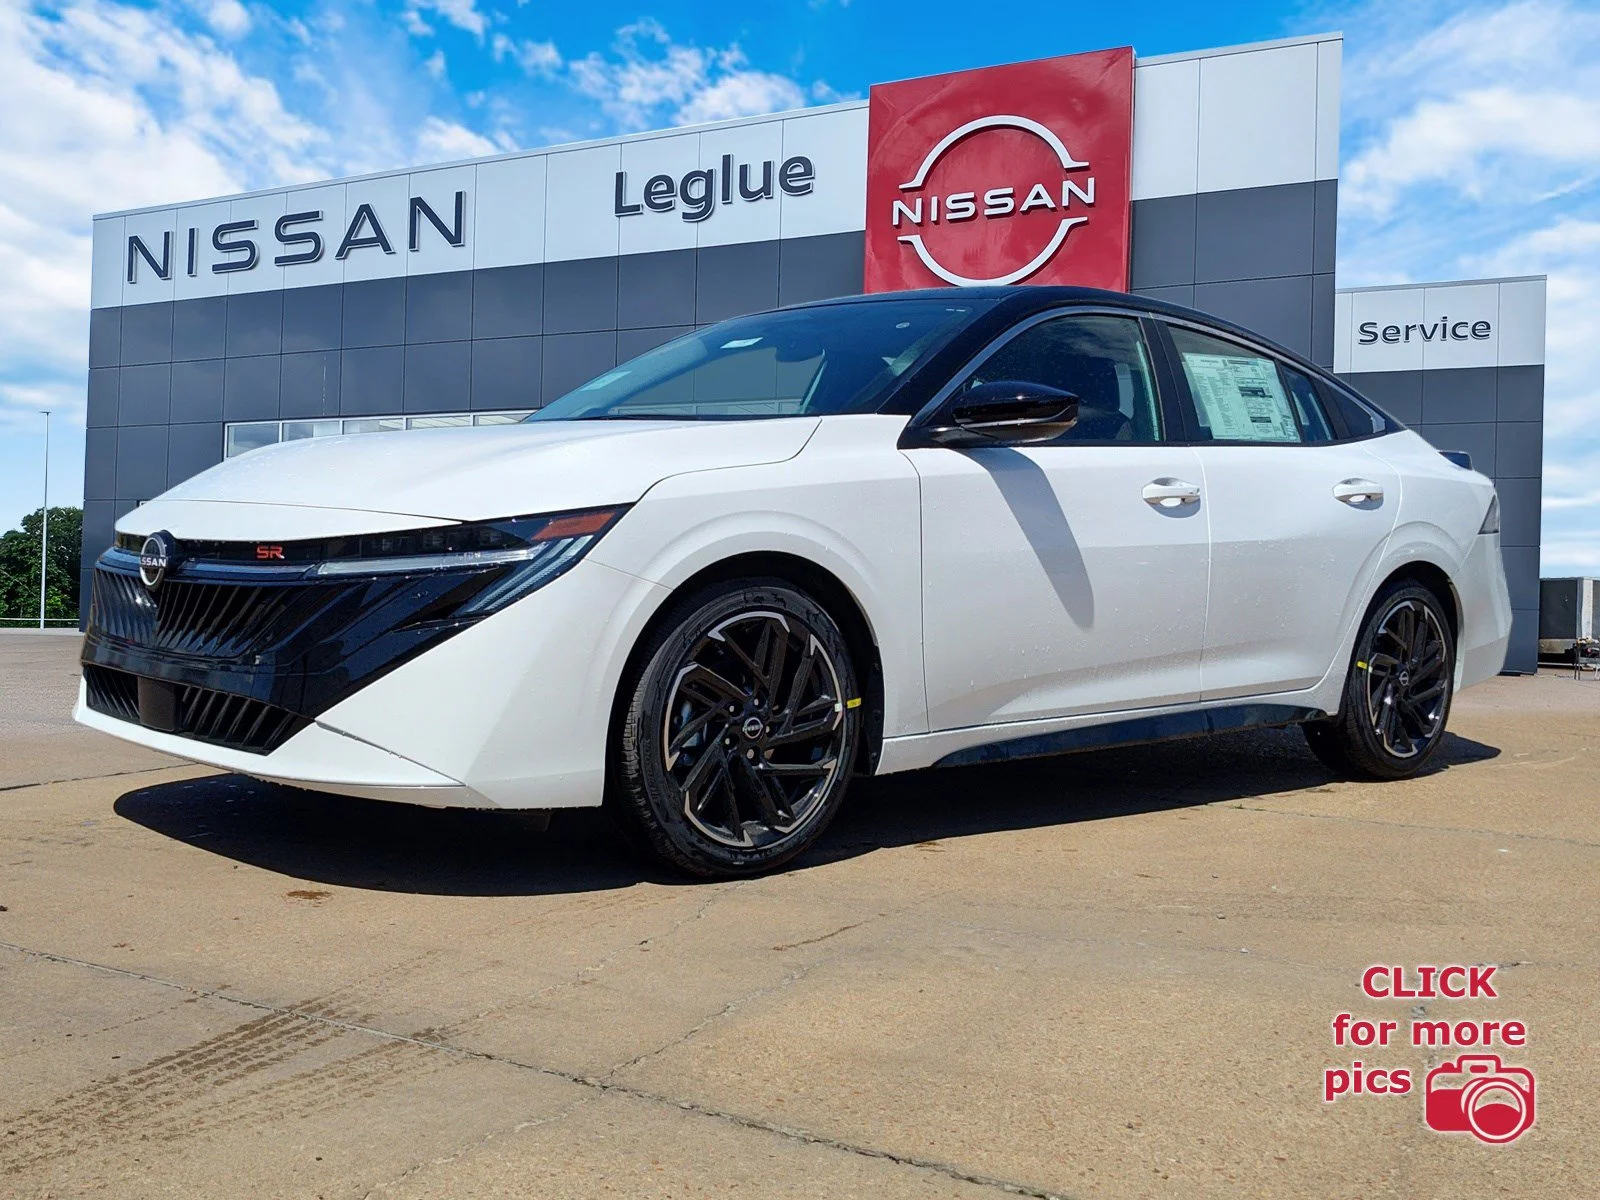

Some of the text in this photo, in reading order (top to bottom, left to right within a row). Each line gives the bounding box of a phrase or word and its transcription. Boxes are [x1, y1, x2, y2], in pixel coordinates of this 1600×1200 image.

[127, 153, 815, 284] NISSAN Leglue
[892, 177, 1095, 227] NISSAN
[1358, 316, 1491, 345] Service
[256, 545, 285, 559] SR
